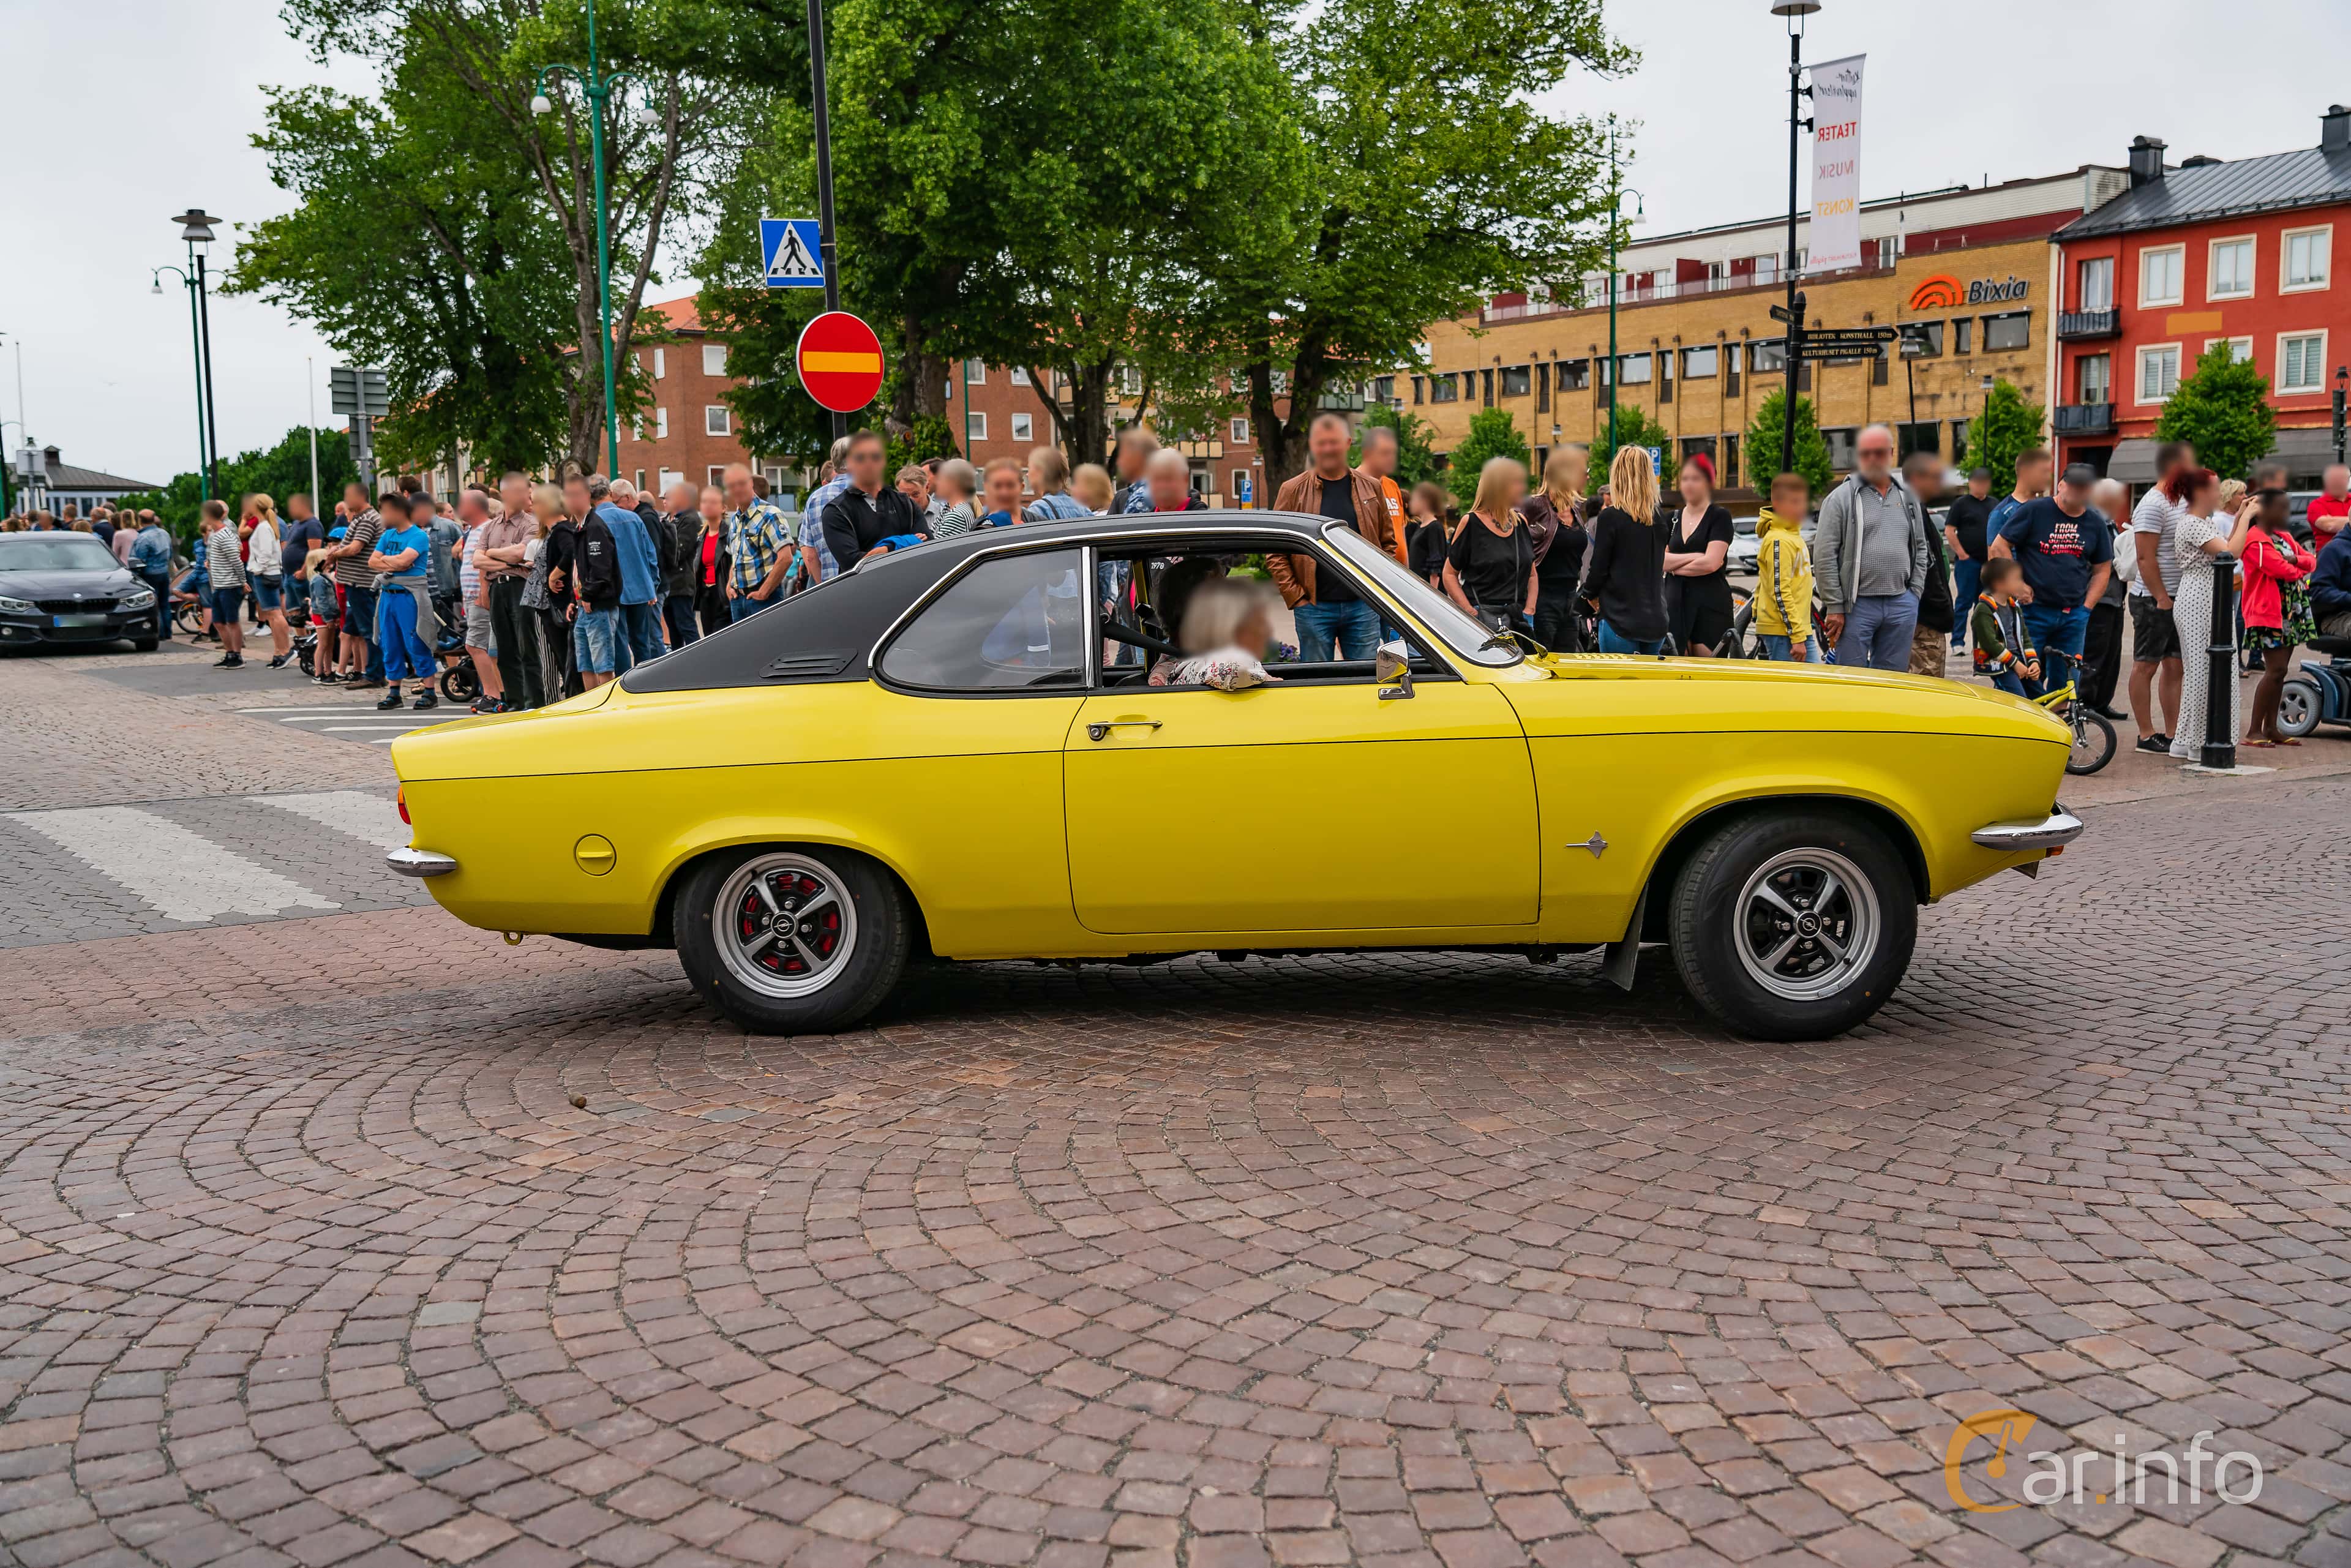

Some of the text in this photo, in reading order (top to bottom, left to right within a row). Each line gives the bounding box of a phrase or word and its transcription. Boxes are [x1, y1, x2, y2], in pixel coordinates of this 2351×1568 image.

[1968, 274, 2029, 304] Bixia
[1651, 449, 1658, 463] P
[1244, 482, 1251, 492] P
[2054, 523, 2079, 533] FROM
[2048, 533, 2080, 544] SUNSET
[2039, 541, 2085, 557] TO SUNRISE
